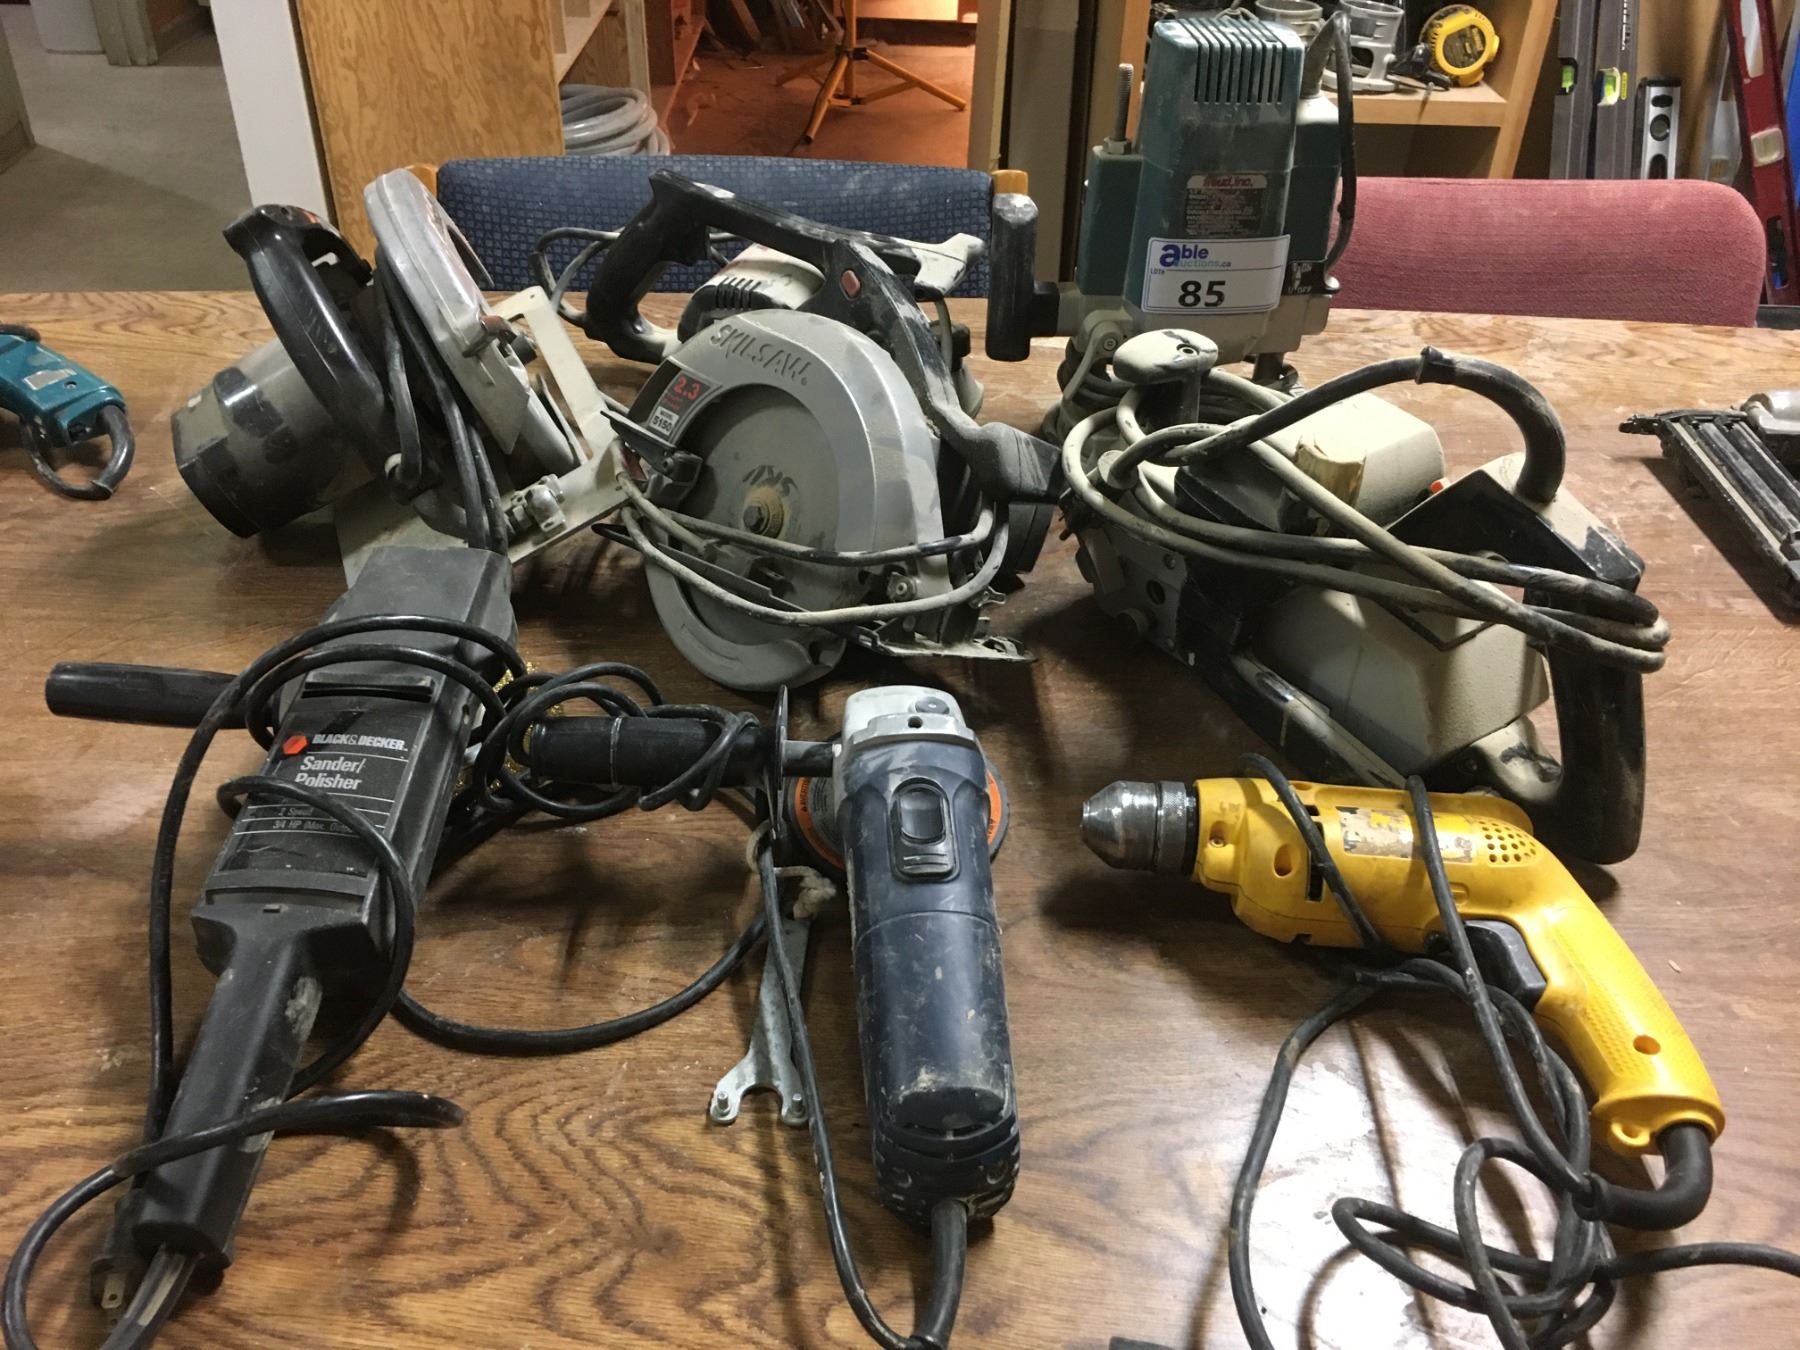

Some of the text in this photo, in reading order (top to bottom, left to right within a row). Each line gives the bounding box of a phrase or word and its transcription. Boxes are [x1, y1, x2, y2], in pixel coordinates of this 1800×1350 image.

[1159, 244, 1209, 267] able
[1178, 280, 1226, 307] 85
[673, 375, 702, 401] 2.3
[652, 415, 673, 432] 5150
[300, 756, 367, 773] Sander/
[295, 773, 362, 790] Polisher
